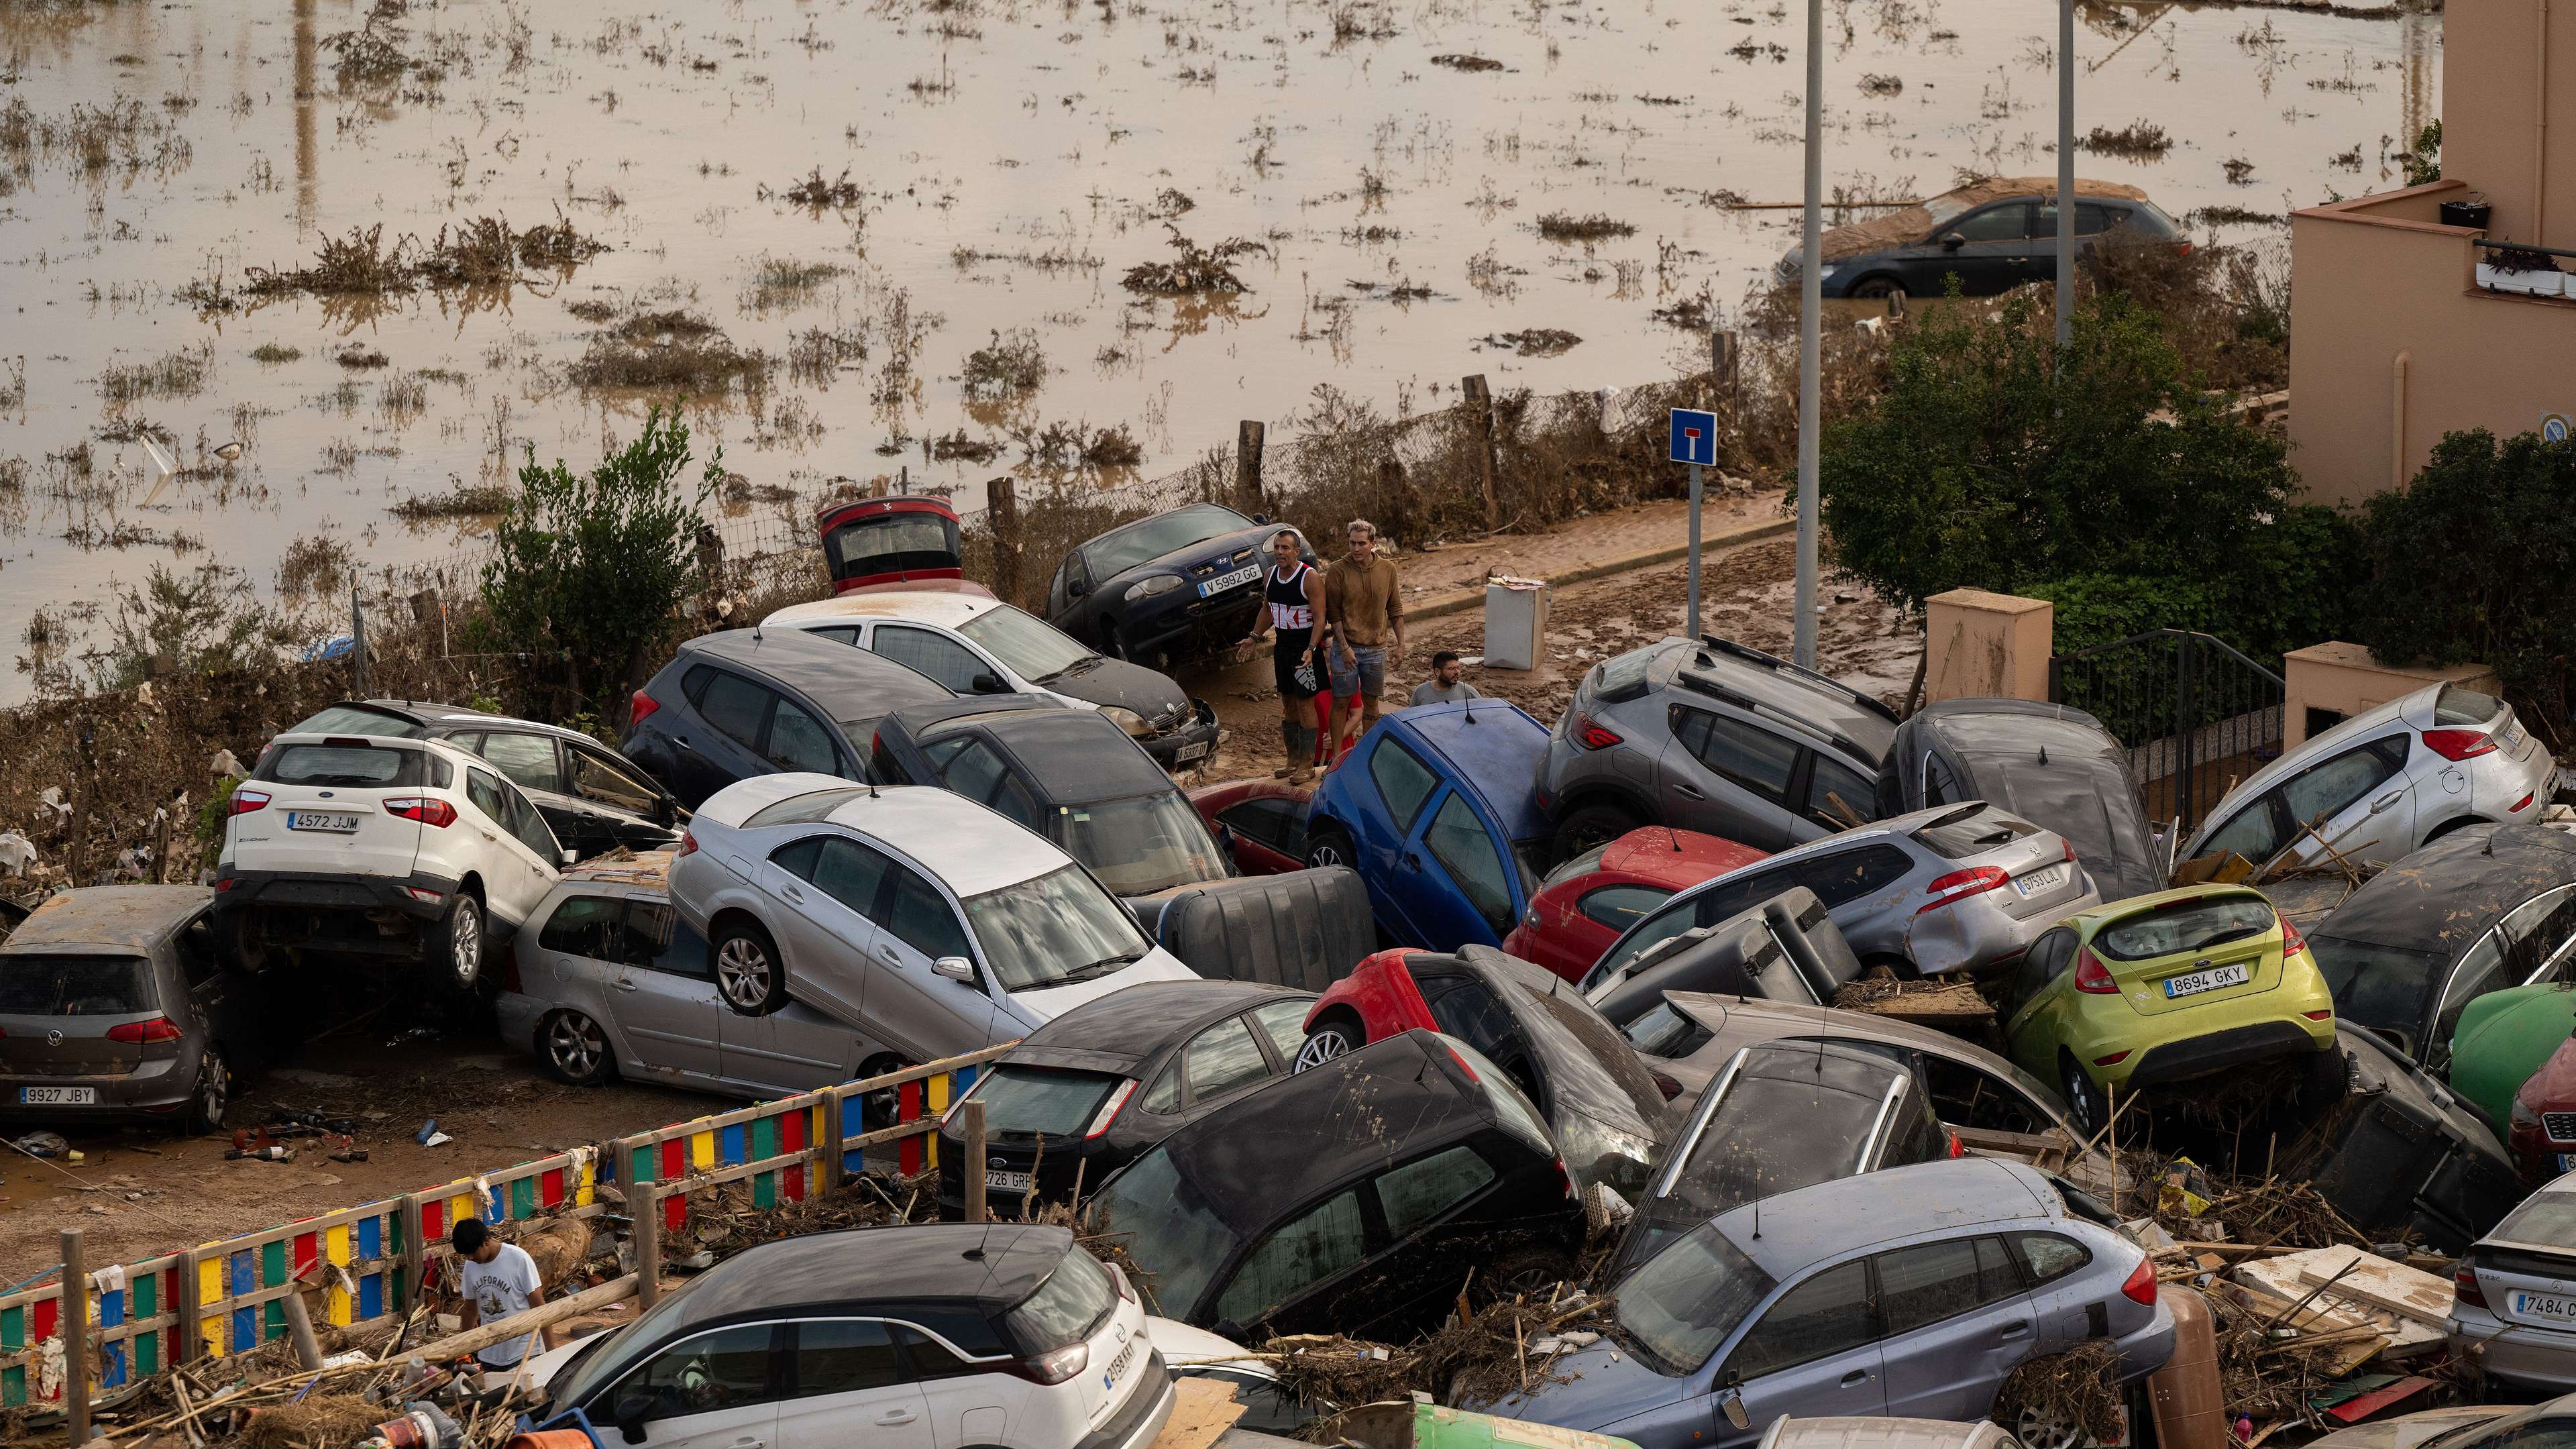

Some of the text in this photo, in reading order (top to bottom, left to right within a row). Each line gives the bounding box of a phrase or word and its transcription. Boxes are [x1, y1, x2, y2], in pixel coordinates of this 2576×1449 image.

[1206, 567, 1257, 592] V 5992 GG
[1267, 602, 1313, 630] IKE
[1184, 745, 1198, 759] 5337
[2437, 765, 2454, 776] GASOLINA
[297, 814, 358, 829] 4572 JJM
[2023, 875, 2044, 890] 6753
[2041, 869, 2059, 884] LJL
[2174, 974, 2210, 992] 8694
[2214, 967, 2241, 983] GKY
[28, 1089, 91, 1102] 9927 JBY
[2527, 1296, 2563, 1315] 7484
[1107, 1355, 1126, 1383] 2158
